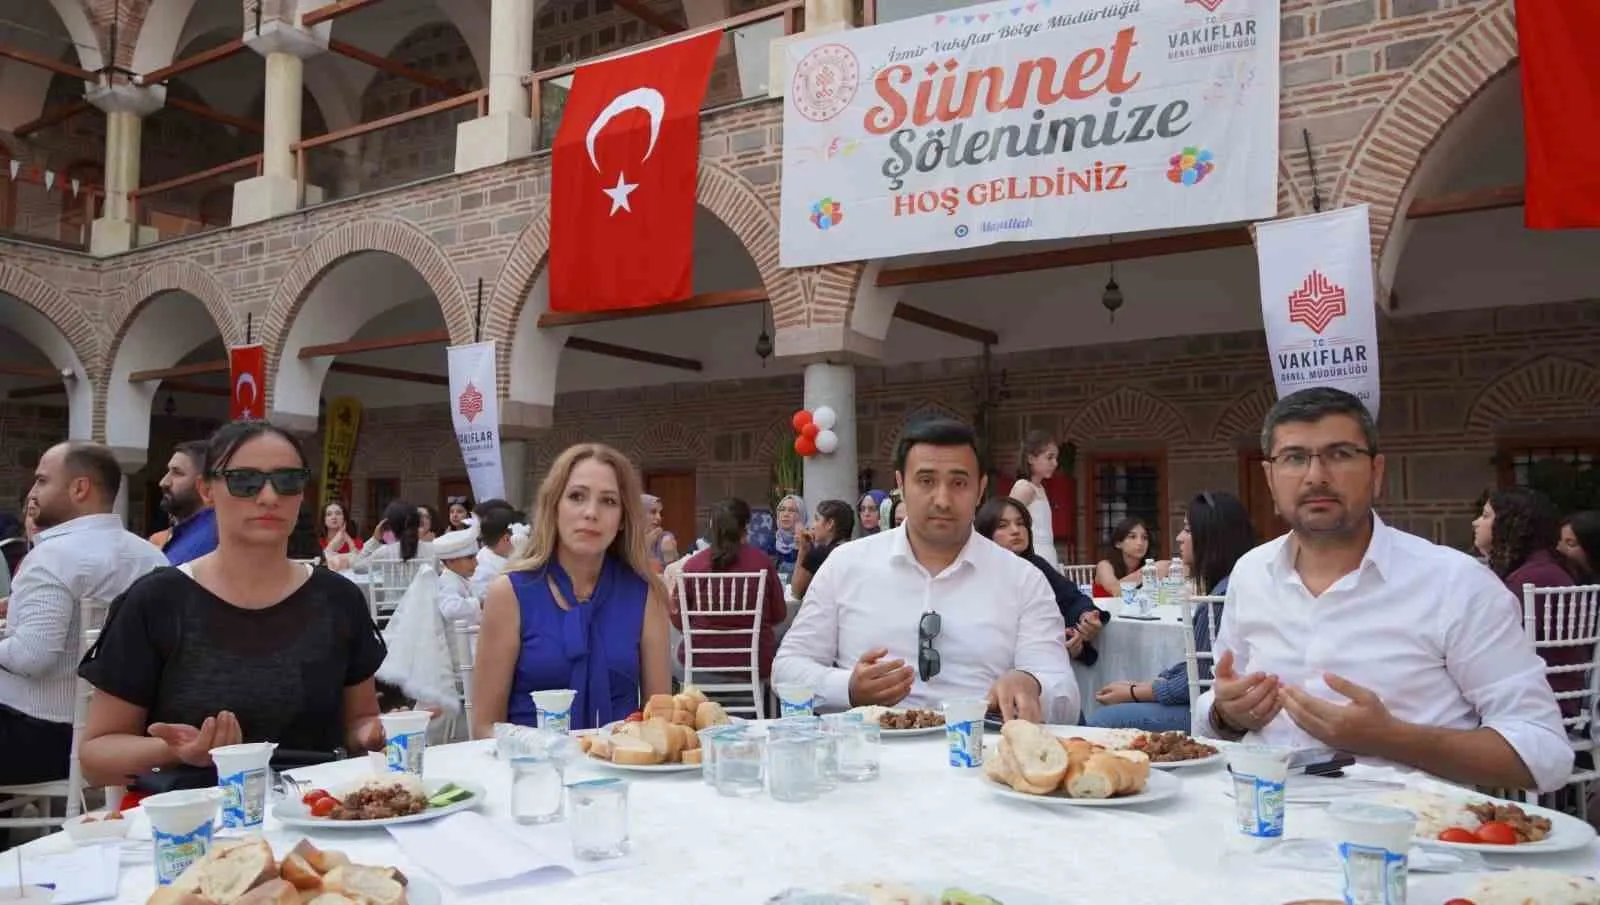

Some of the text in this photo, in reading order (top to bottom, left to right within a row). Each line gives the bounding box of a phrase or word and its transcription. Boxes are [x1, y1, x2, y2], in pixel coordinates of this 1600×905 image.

[888, 46, 927, 62] İzmir
[1168, 20, 1256, 48] VAKIFLAR
[863, 26, 1142, 134] Sünnet
[881, 97, 1192, 191] Şölenimize
[893, 161, 1129, 217] HOŞ GELDİNİZ
[1279, 345, 1367, 369] VAKIFLAR
